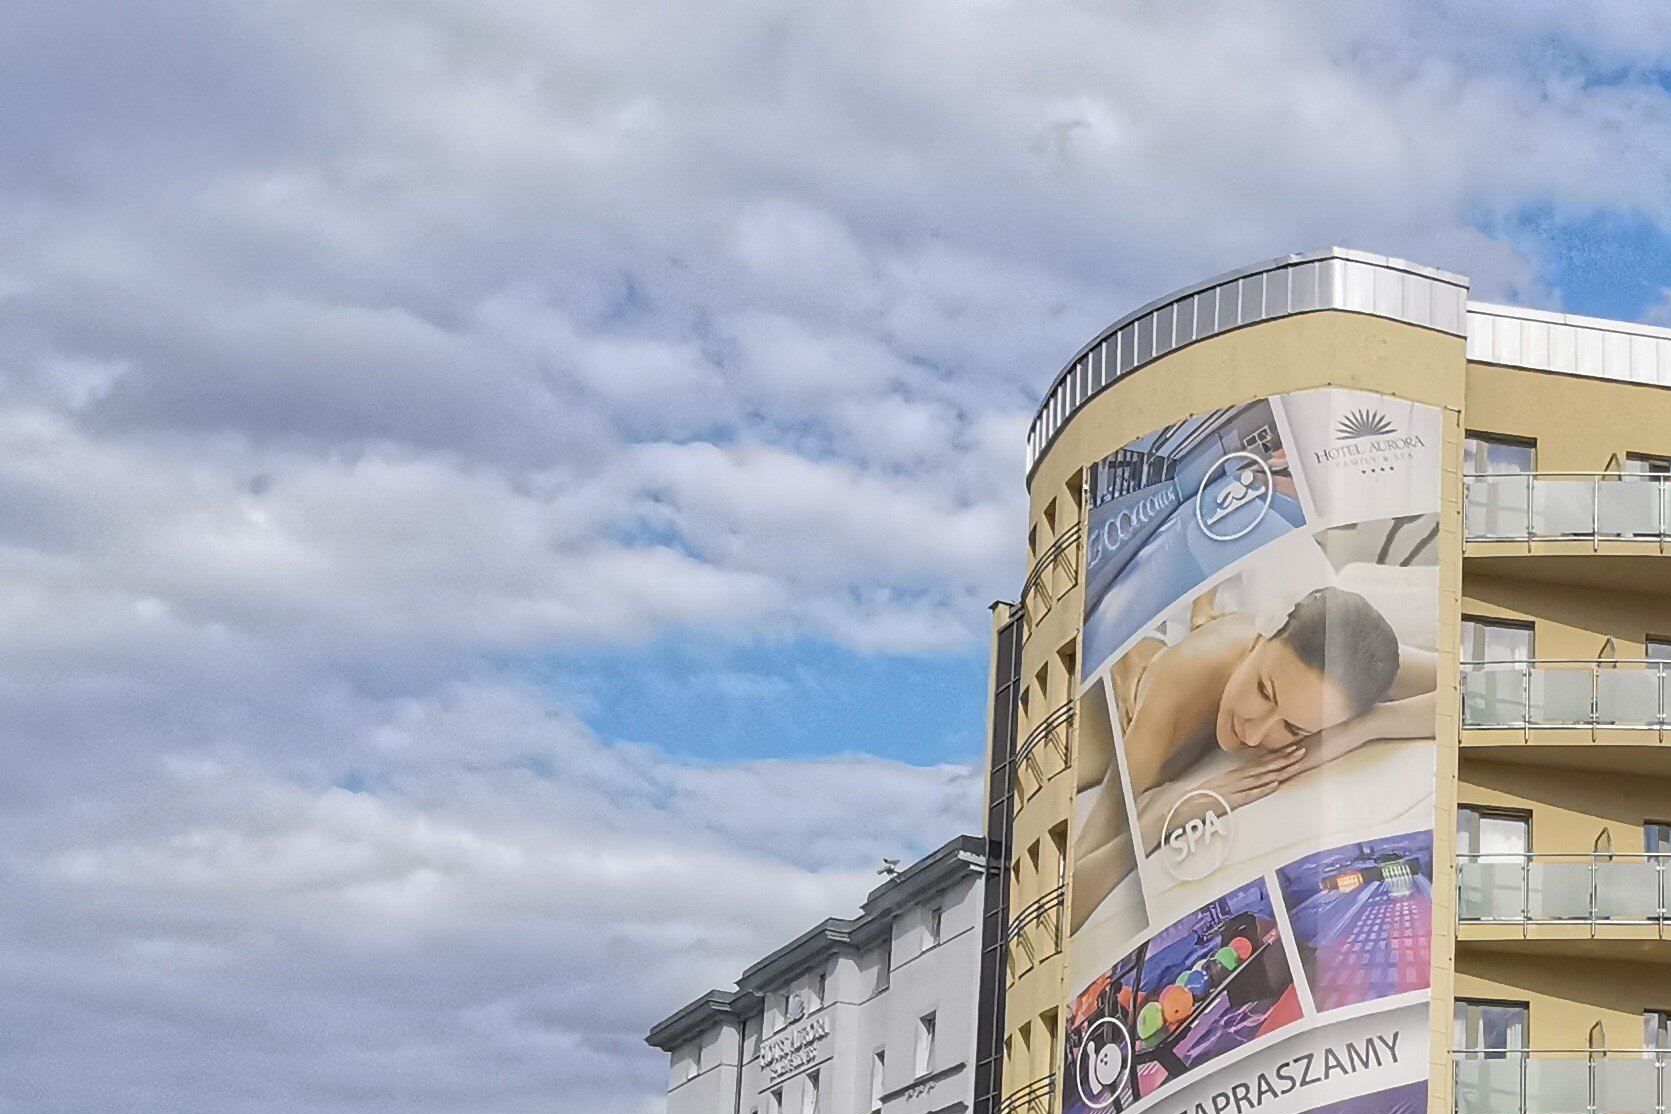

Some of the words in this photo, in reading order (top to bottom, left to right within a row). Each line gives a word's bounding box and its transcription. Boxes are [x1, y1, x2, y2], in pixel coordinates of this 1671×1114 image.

[1315, 443, 1364, 464] HOTEL
[1368, 435, 1425, 454] AURORA
[1335, 456, 1377, 470] FAMILY
[1169, 809, 1229, 864] SPA
